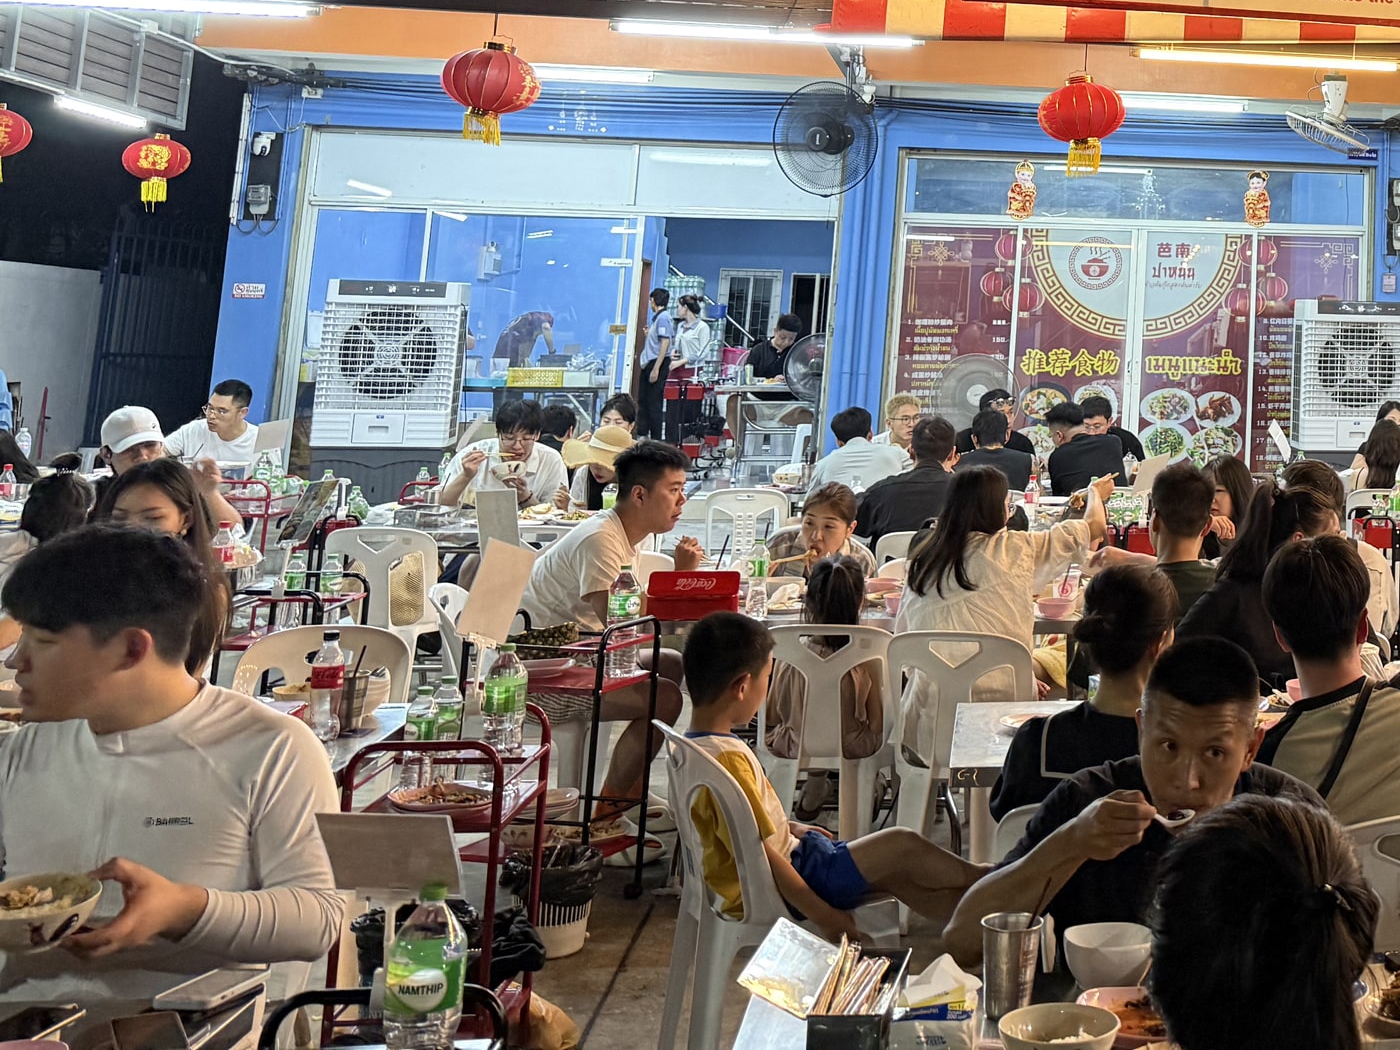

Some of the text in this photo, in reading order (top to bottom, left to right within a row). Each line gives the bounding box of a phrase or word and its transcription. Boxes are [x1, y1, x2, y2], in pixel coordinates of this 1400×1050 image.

[1019, 348, 1121, 377] 推荐食物
[1144, 349, 1242, 381] เมนูแนะนำ
[398, 982, 444, 997] NAMTHIP
